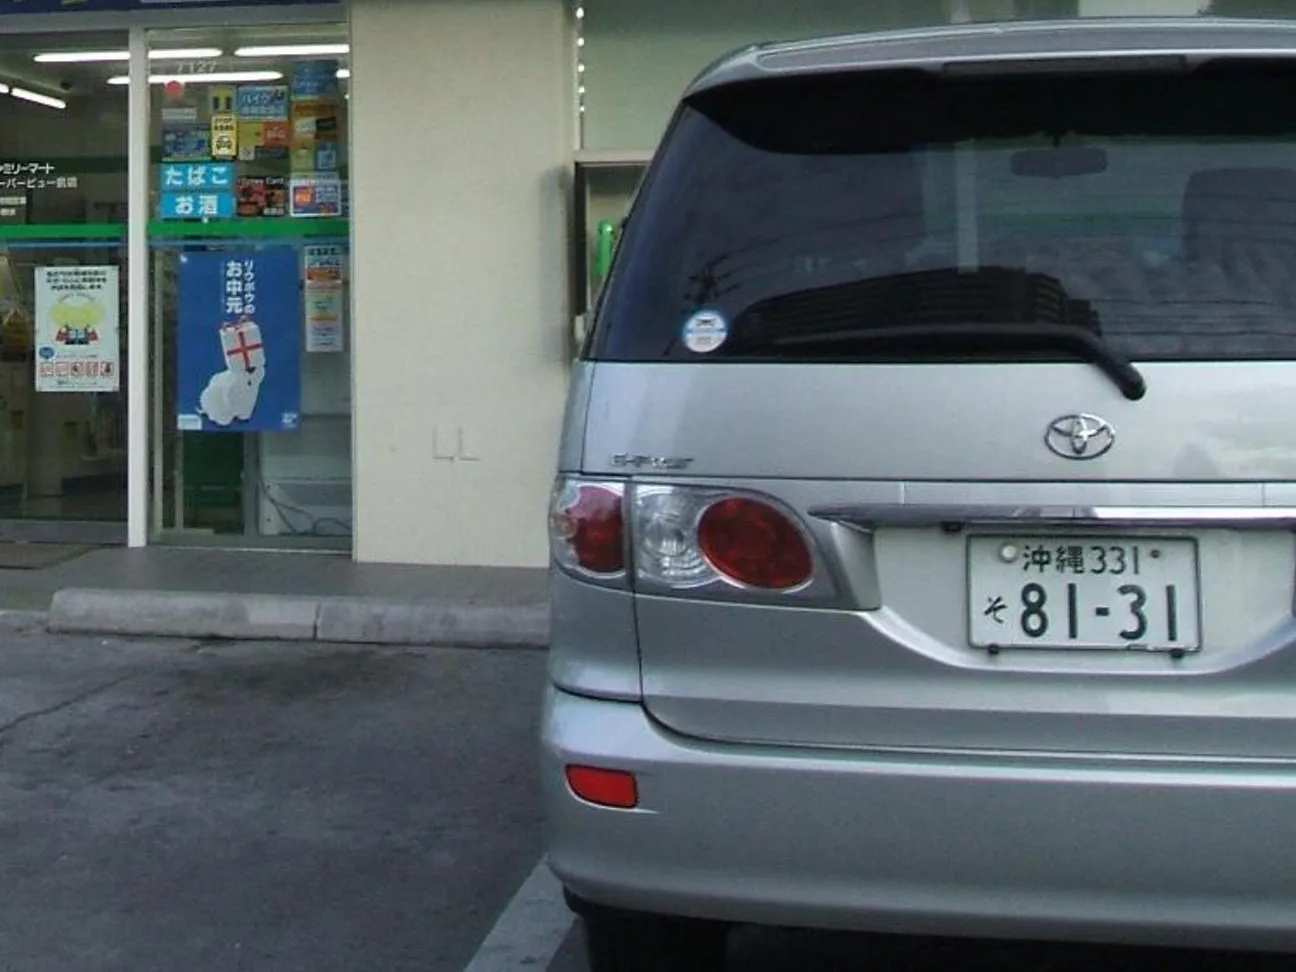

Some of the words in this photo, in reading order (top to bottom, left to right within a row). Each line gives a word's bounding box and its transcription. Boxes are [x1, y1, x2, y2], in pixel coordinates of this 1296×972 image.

[165, 165, 227, 186] たばこ
[175, 195, 217, 215] お酒
[226, 259, 243, 314] お中元
[1022, 544, 1139, 575] 沖縄331
[984, 596, 1007, 624] そ
[1020, 583, 1177, 641] 81-31
